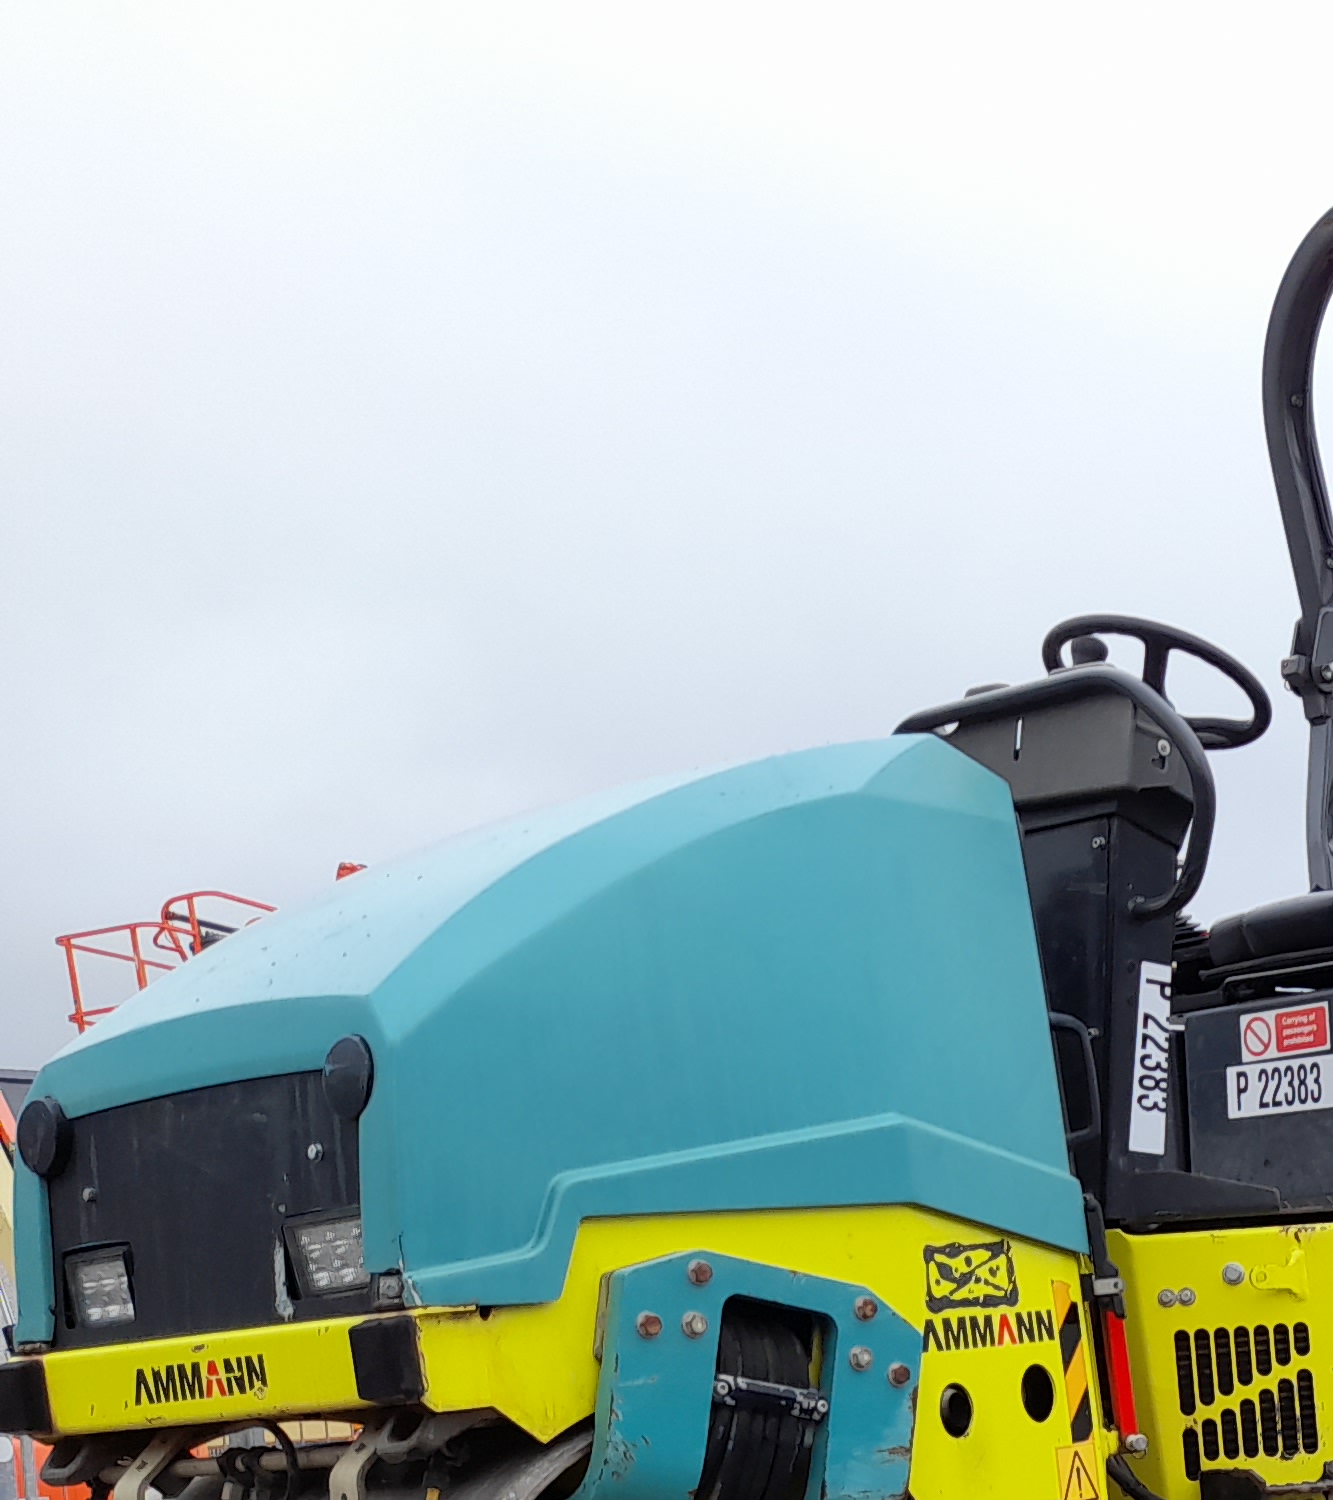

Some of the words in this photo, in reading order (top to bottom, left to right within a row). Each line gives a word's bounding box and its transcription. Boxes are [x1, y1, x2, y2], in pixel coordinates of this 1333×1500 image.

[1136, 1012, 1170, 1113] 22383
[1236, 1071, 1249, 1111] P
[1258, 1062, 1322, 1109] 22383
[922, 1309, 1055, 1353] AMMANN
[134, 1353, 269, 1407] AMMANN
